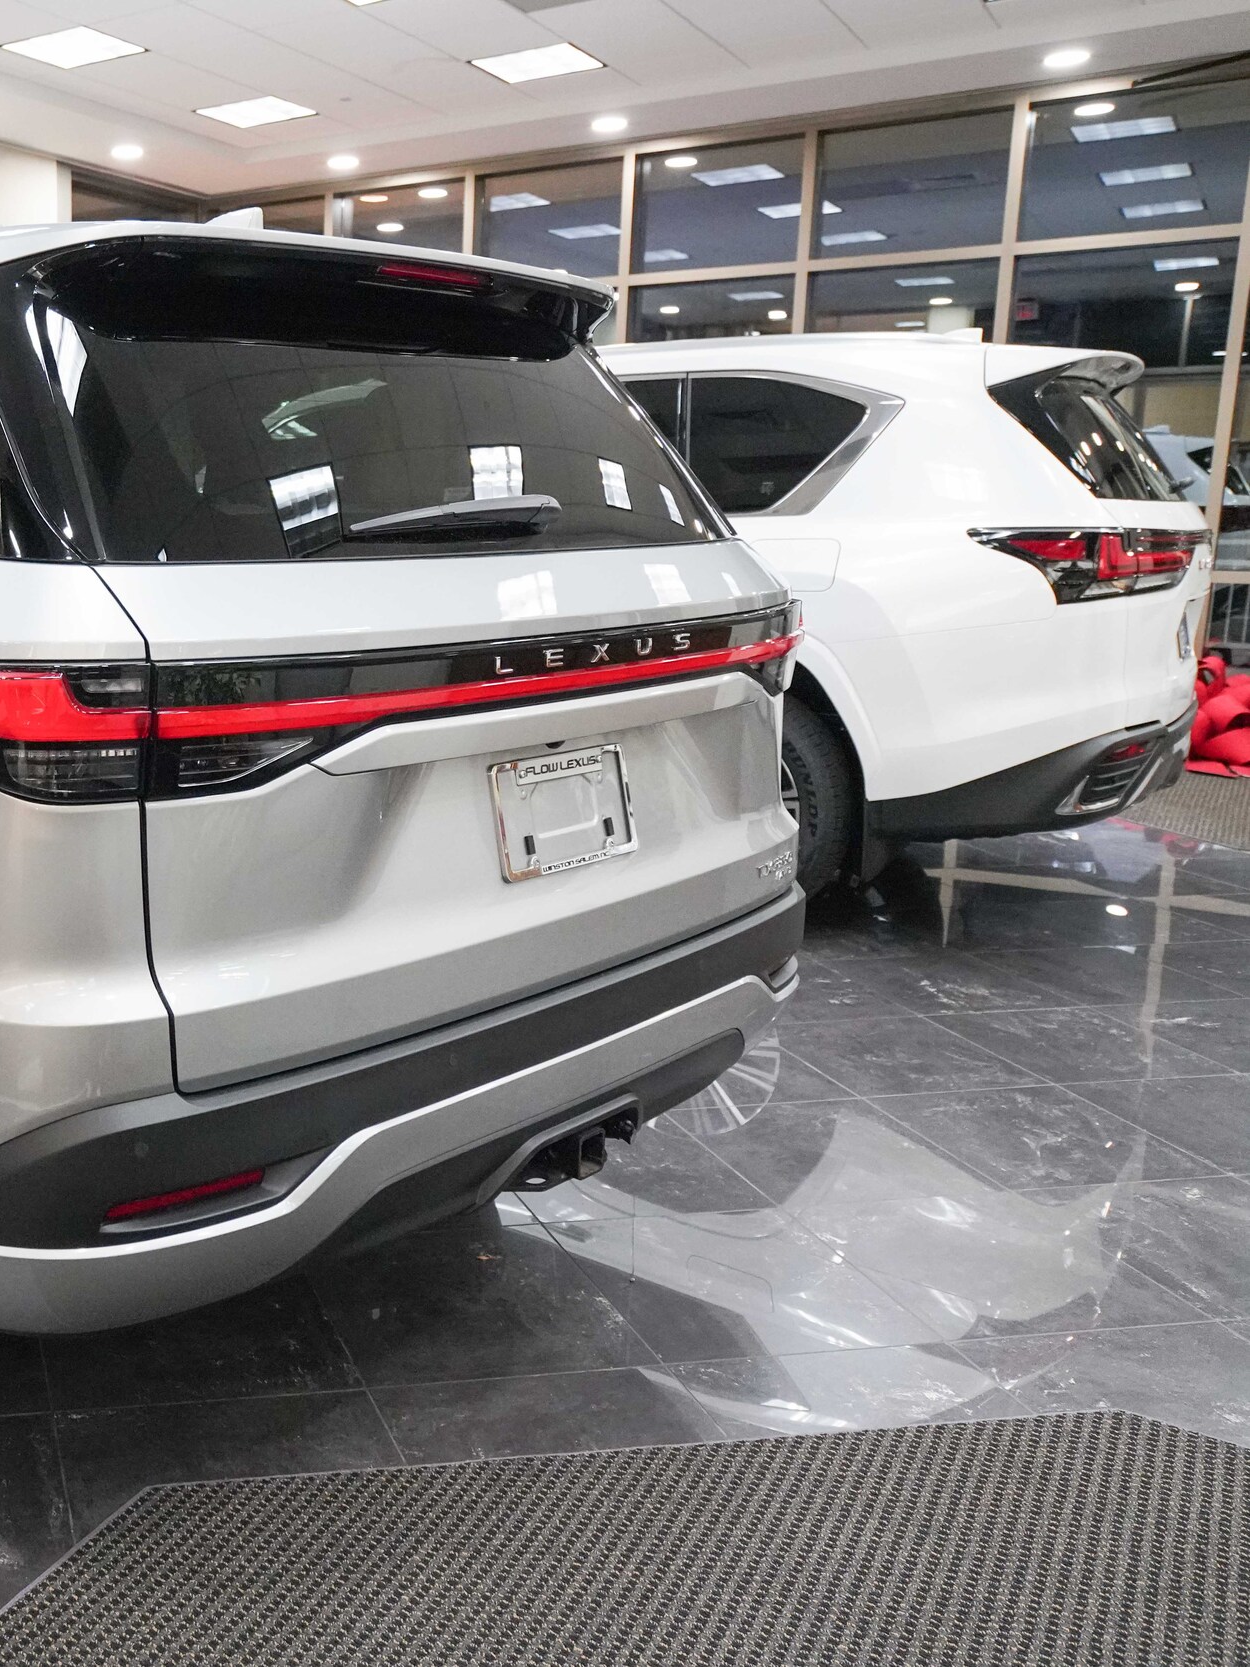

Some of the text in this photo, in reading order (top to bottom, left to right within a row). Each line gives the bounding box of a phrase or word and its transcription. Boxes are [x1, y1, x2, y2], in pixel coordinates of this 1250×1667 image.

[494, 632, 691, 675] LEXUS
[525, 755, 597, 776] FLOW LEXUS
